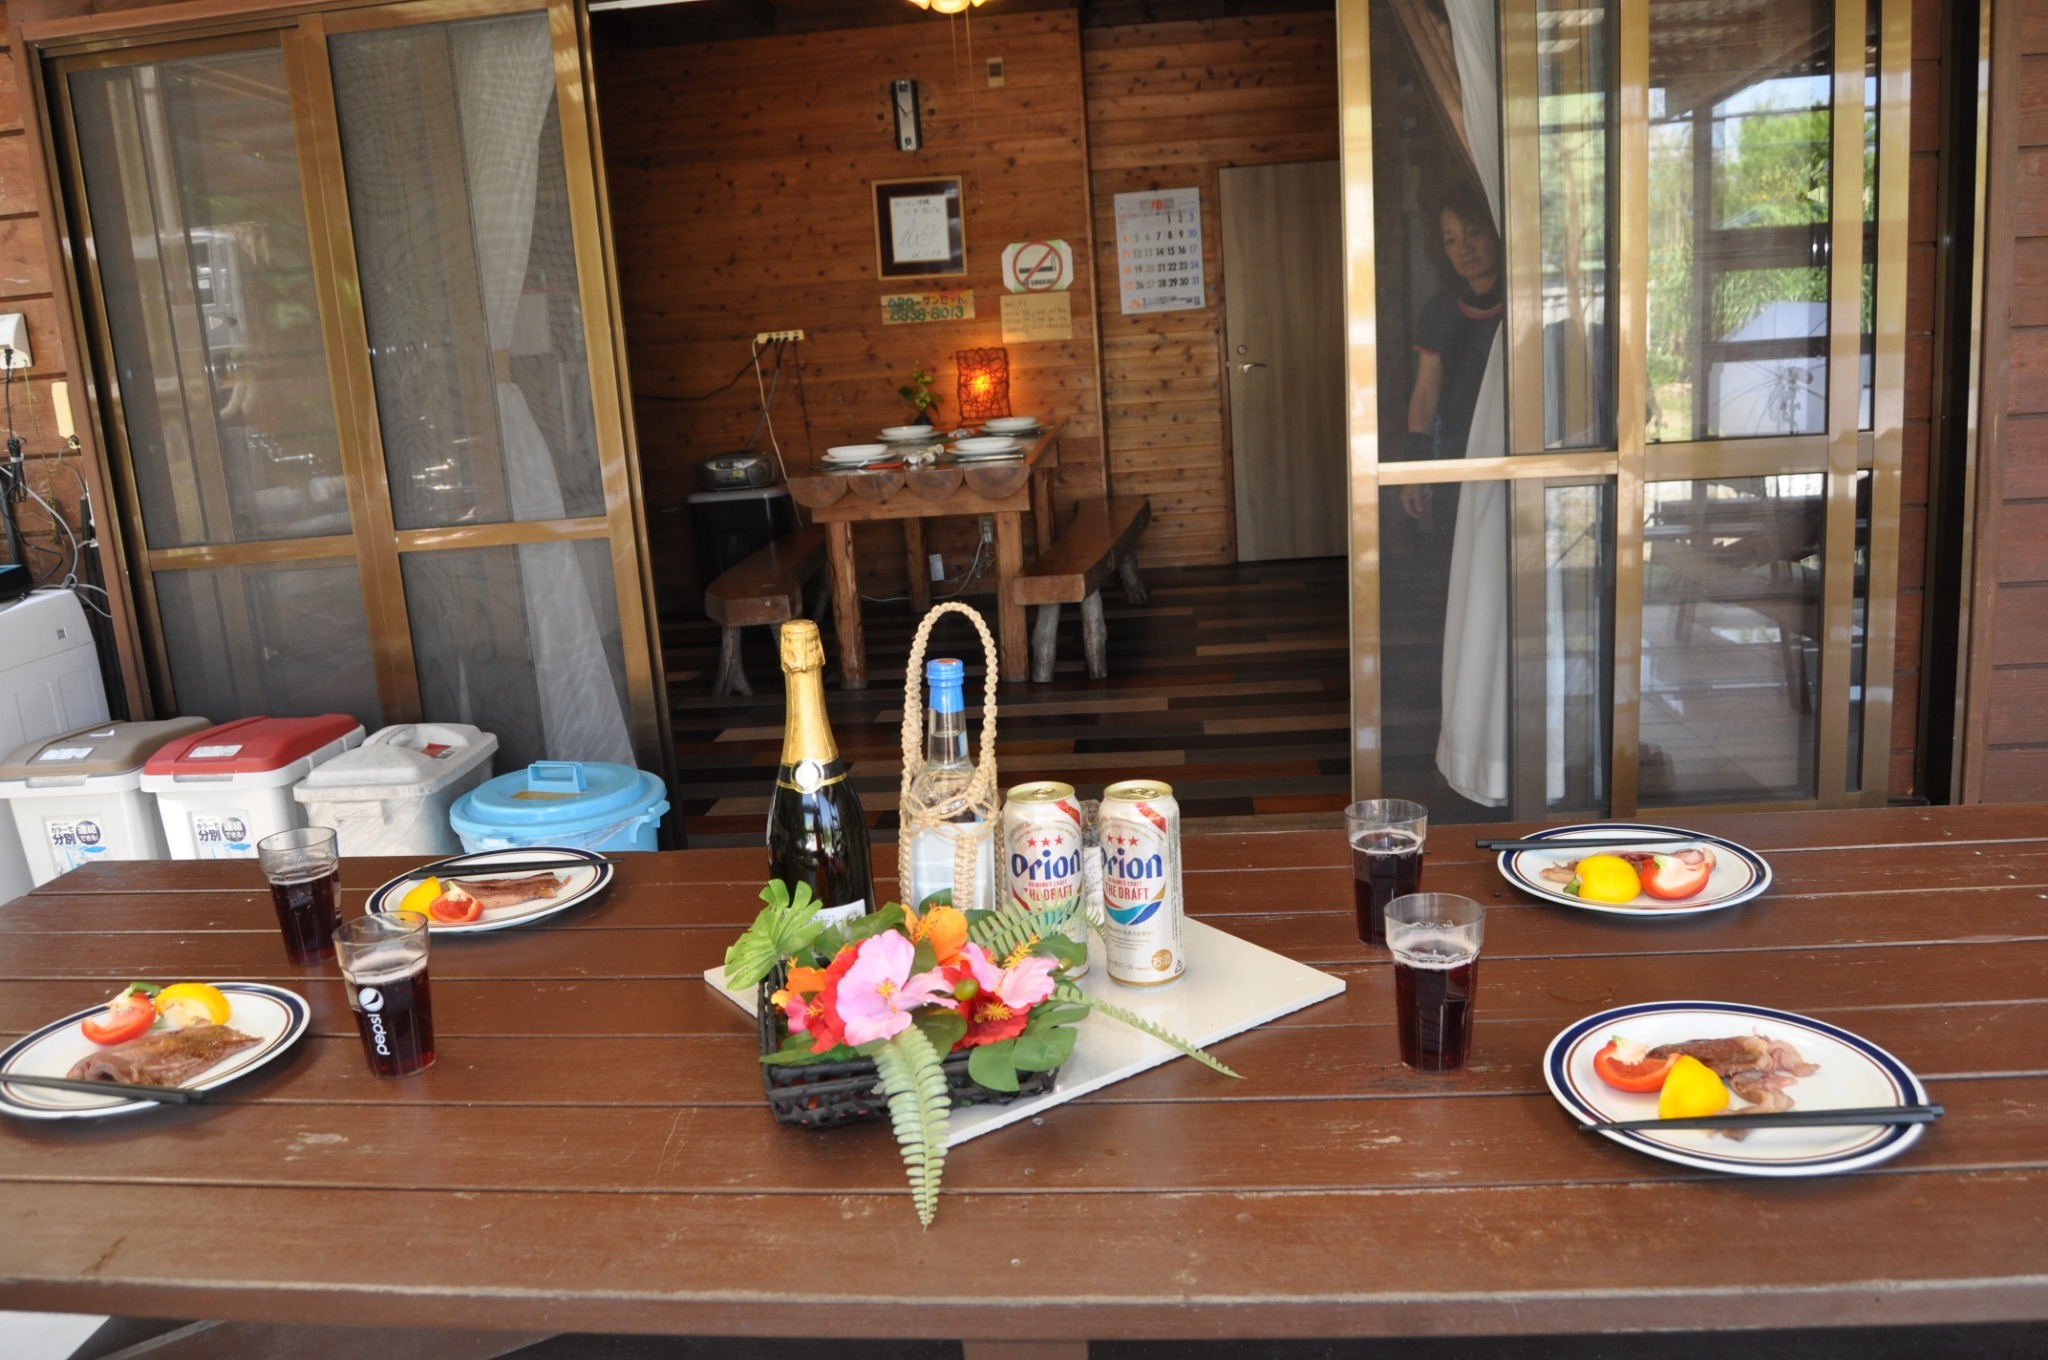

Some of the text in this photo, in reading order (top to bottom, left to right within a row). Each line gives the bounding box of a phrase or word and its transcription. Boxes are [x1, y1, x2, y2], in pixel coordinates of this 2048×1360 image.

[53, 833, 76, 845] 分別
[199, 829, 221, 841] 分別
[1011, 848, 1081, 880] Orion
[1105, 881, 1149, 900] THE DRAFT
[368, 1014, 391, 1055] pepsi
